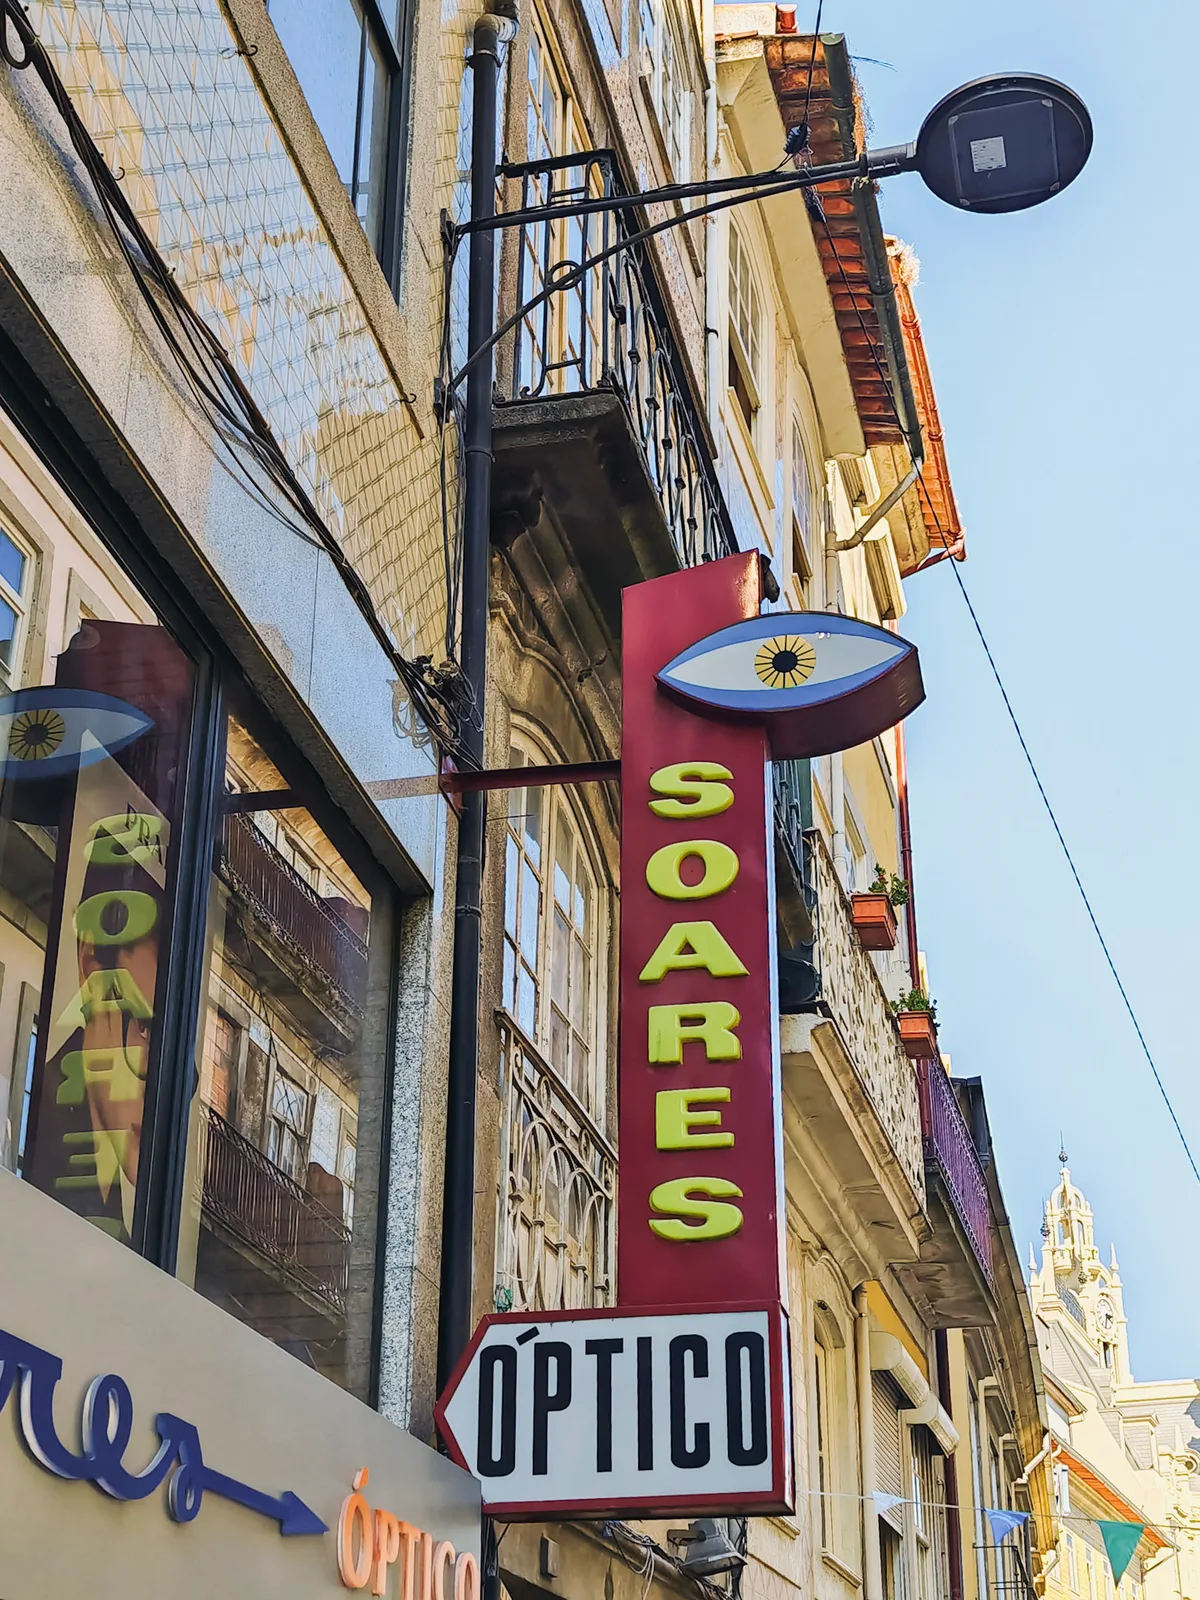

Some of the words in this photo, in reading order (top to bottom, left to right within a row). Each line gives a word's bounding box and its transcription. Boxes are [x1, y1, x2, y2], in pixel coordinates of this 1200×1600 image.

[638, 761, 751, 1243] SOARES
[476, 1325, 769, 1478] ÓPTICO
[337, 1466, 480, 1600] ÓPTICO
